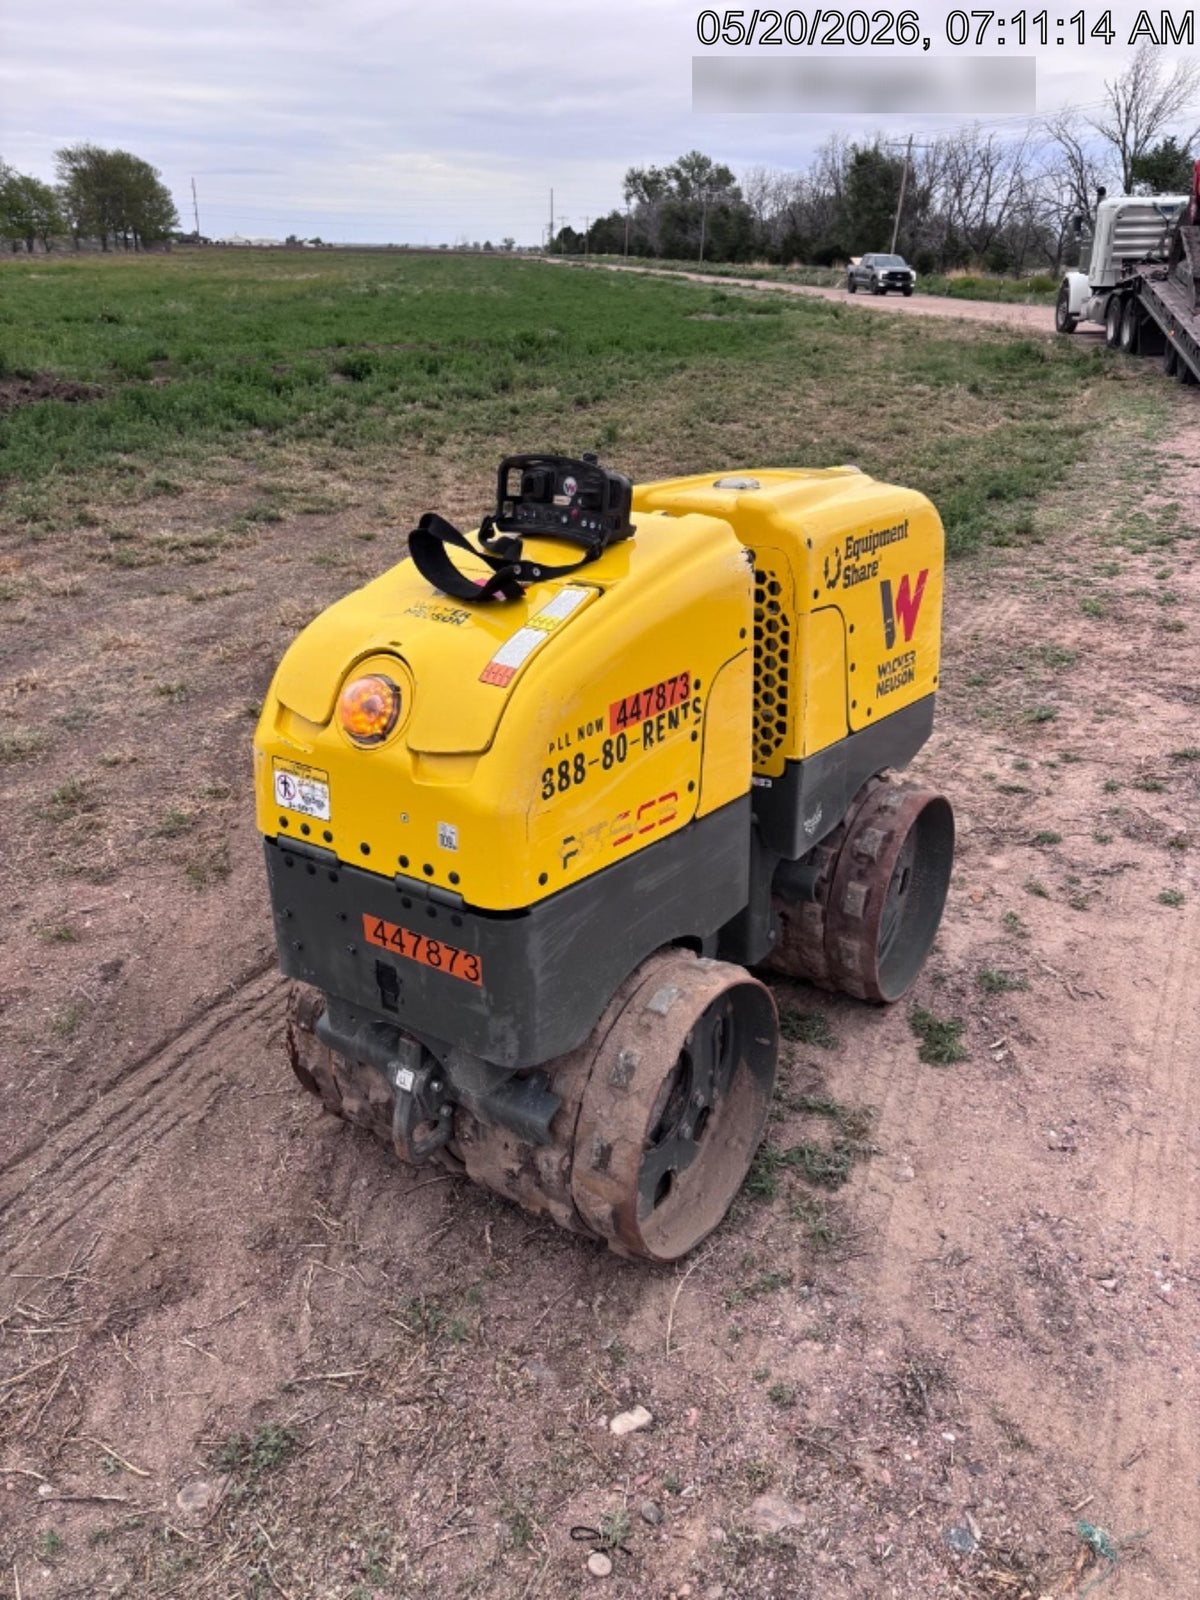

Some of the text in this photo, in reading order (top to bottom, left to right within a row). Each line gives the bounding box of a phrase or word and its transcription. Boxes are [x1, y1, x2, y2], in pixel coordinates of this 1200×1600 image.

[844, 519, 909, 562] Equipment
[842, 560, 879, 589] Share
[616, 671, 691, 728] 447873
[876, 667, 915, 699] NEUSON
[577, 717, 604, 741] NOW
[373, 920, 480, 982] 447873
